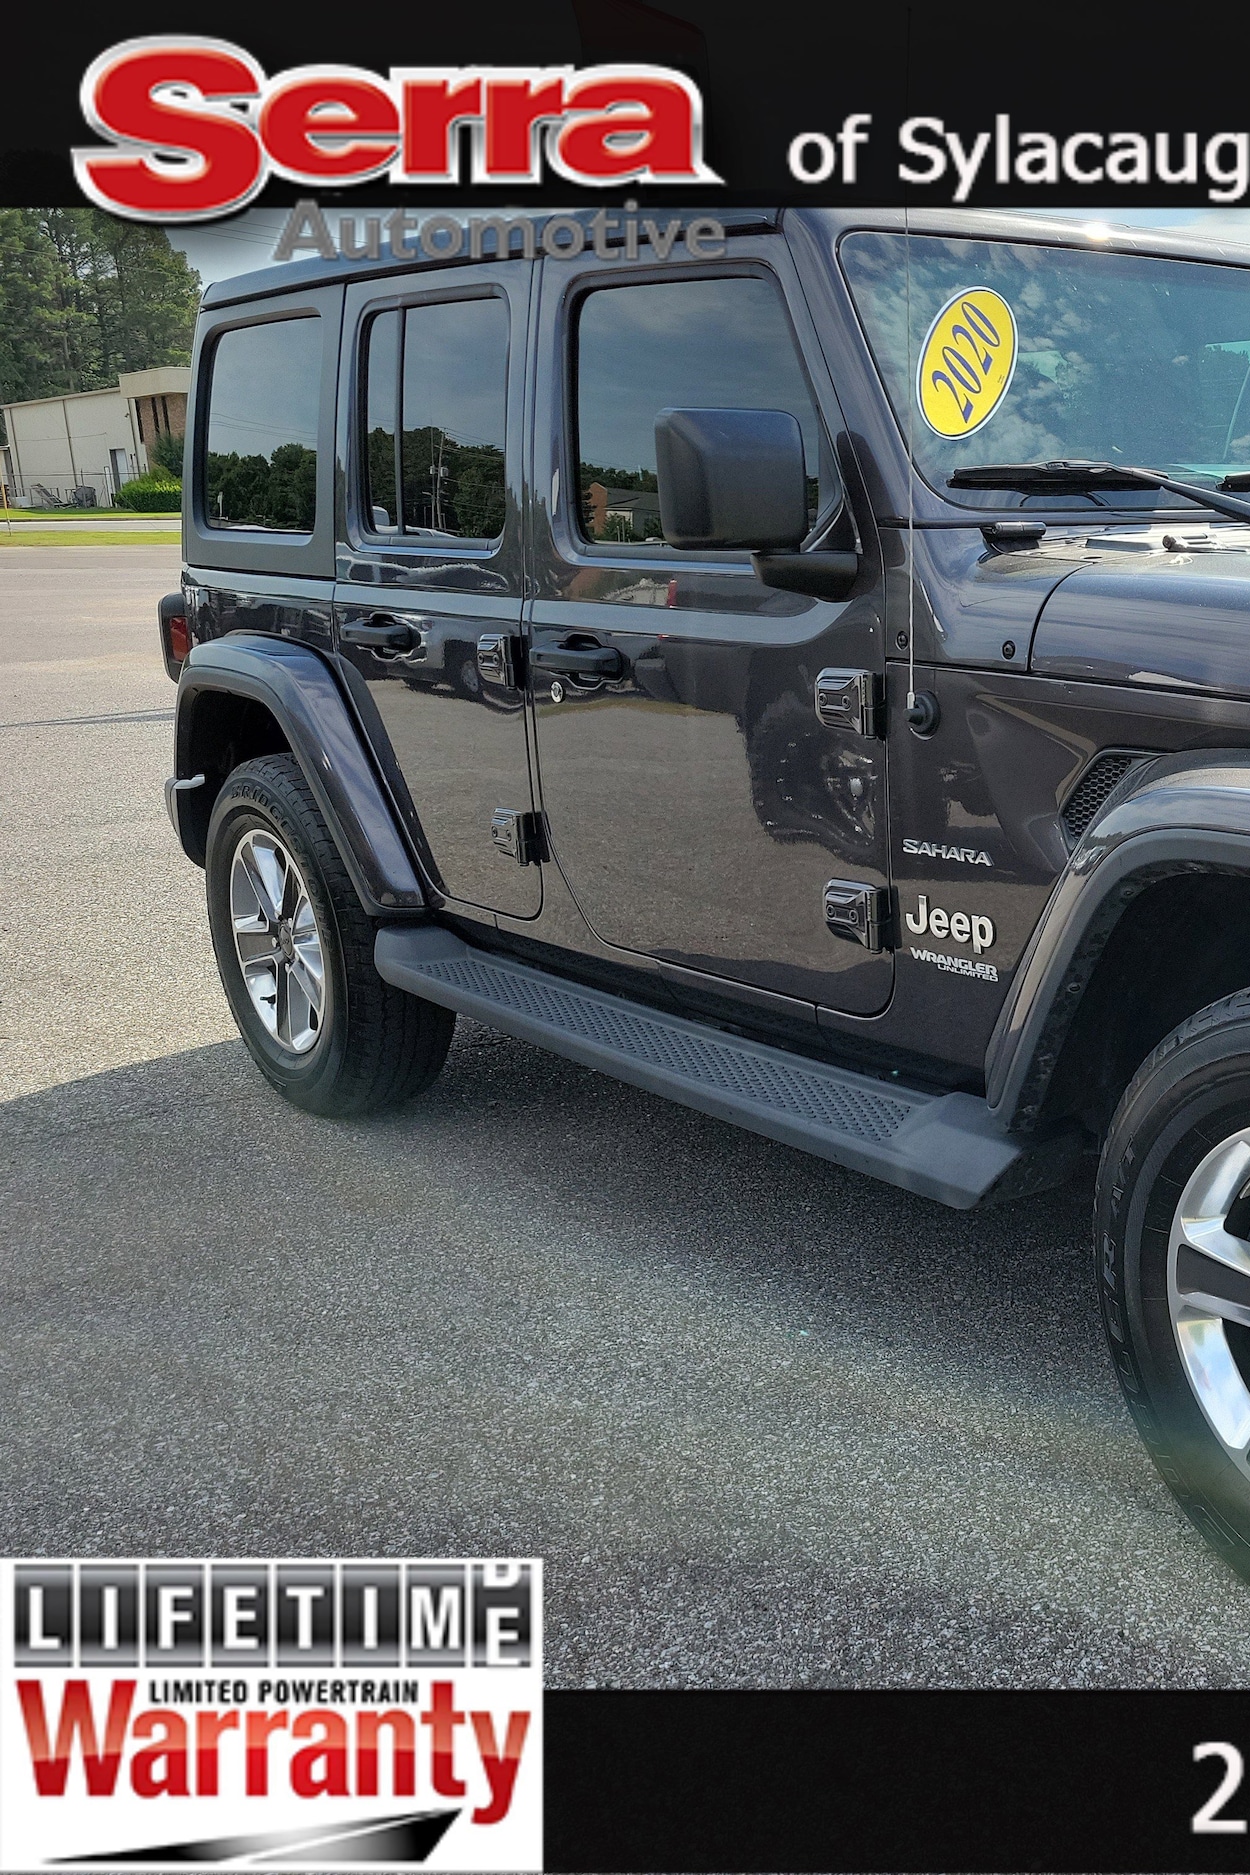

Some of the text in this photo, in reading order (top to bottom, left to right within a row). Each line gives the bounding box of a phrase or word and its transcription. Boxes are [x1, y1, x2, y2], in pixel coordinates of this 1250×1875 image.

[931, 301, 1001, 424] 2020
[902, 838, 995, 867] SAHARA
[905, 894, 996, 955] Jeep
[910, 946, 998, 977] WRANGLER
[937, 963, 999, 983] UNLIMITED
